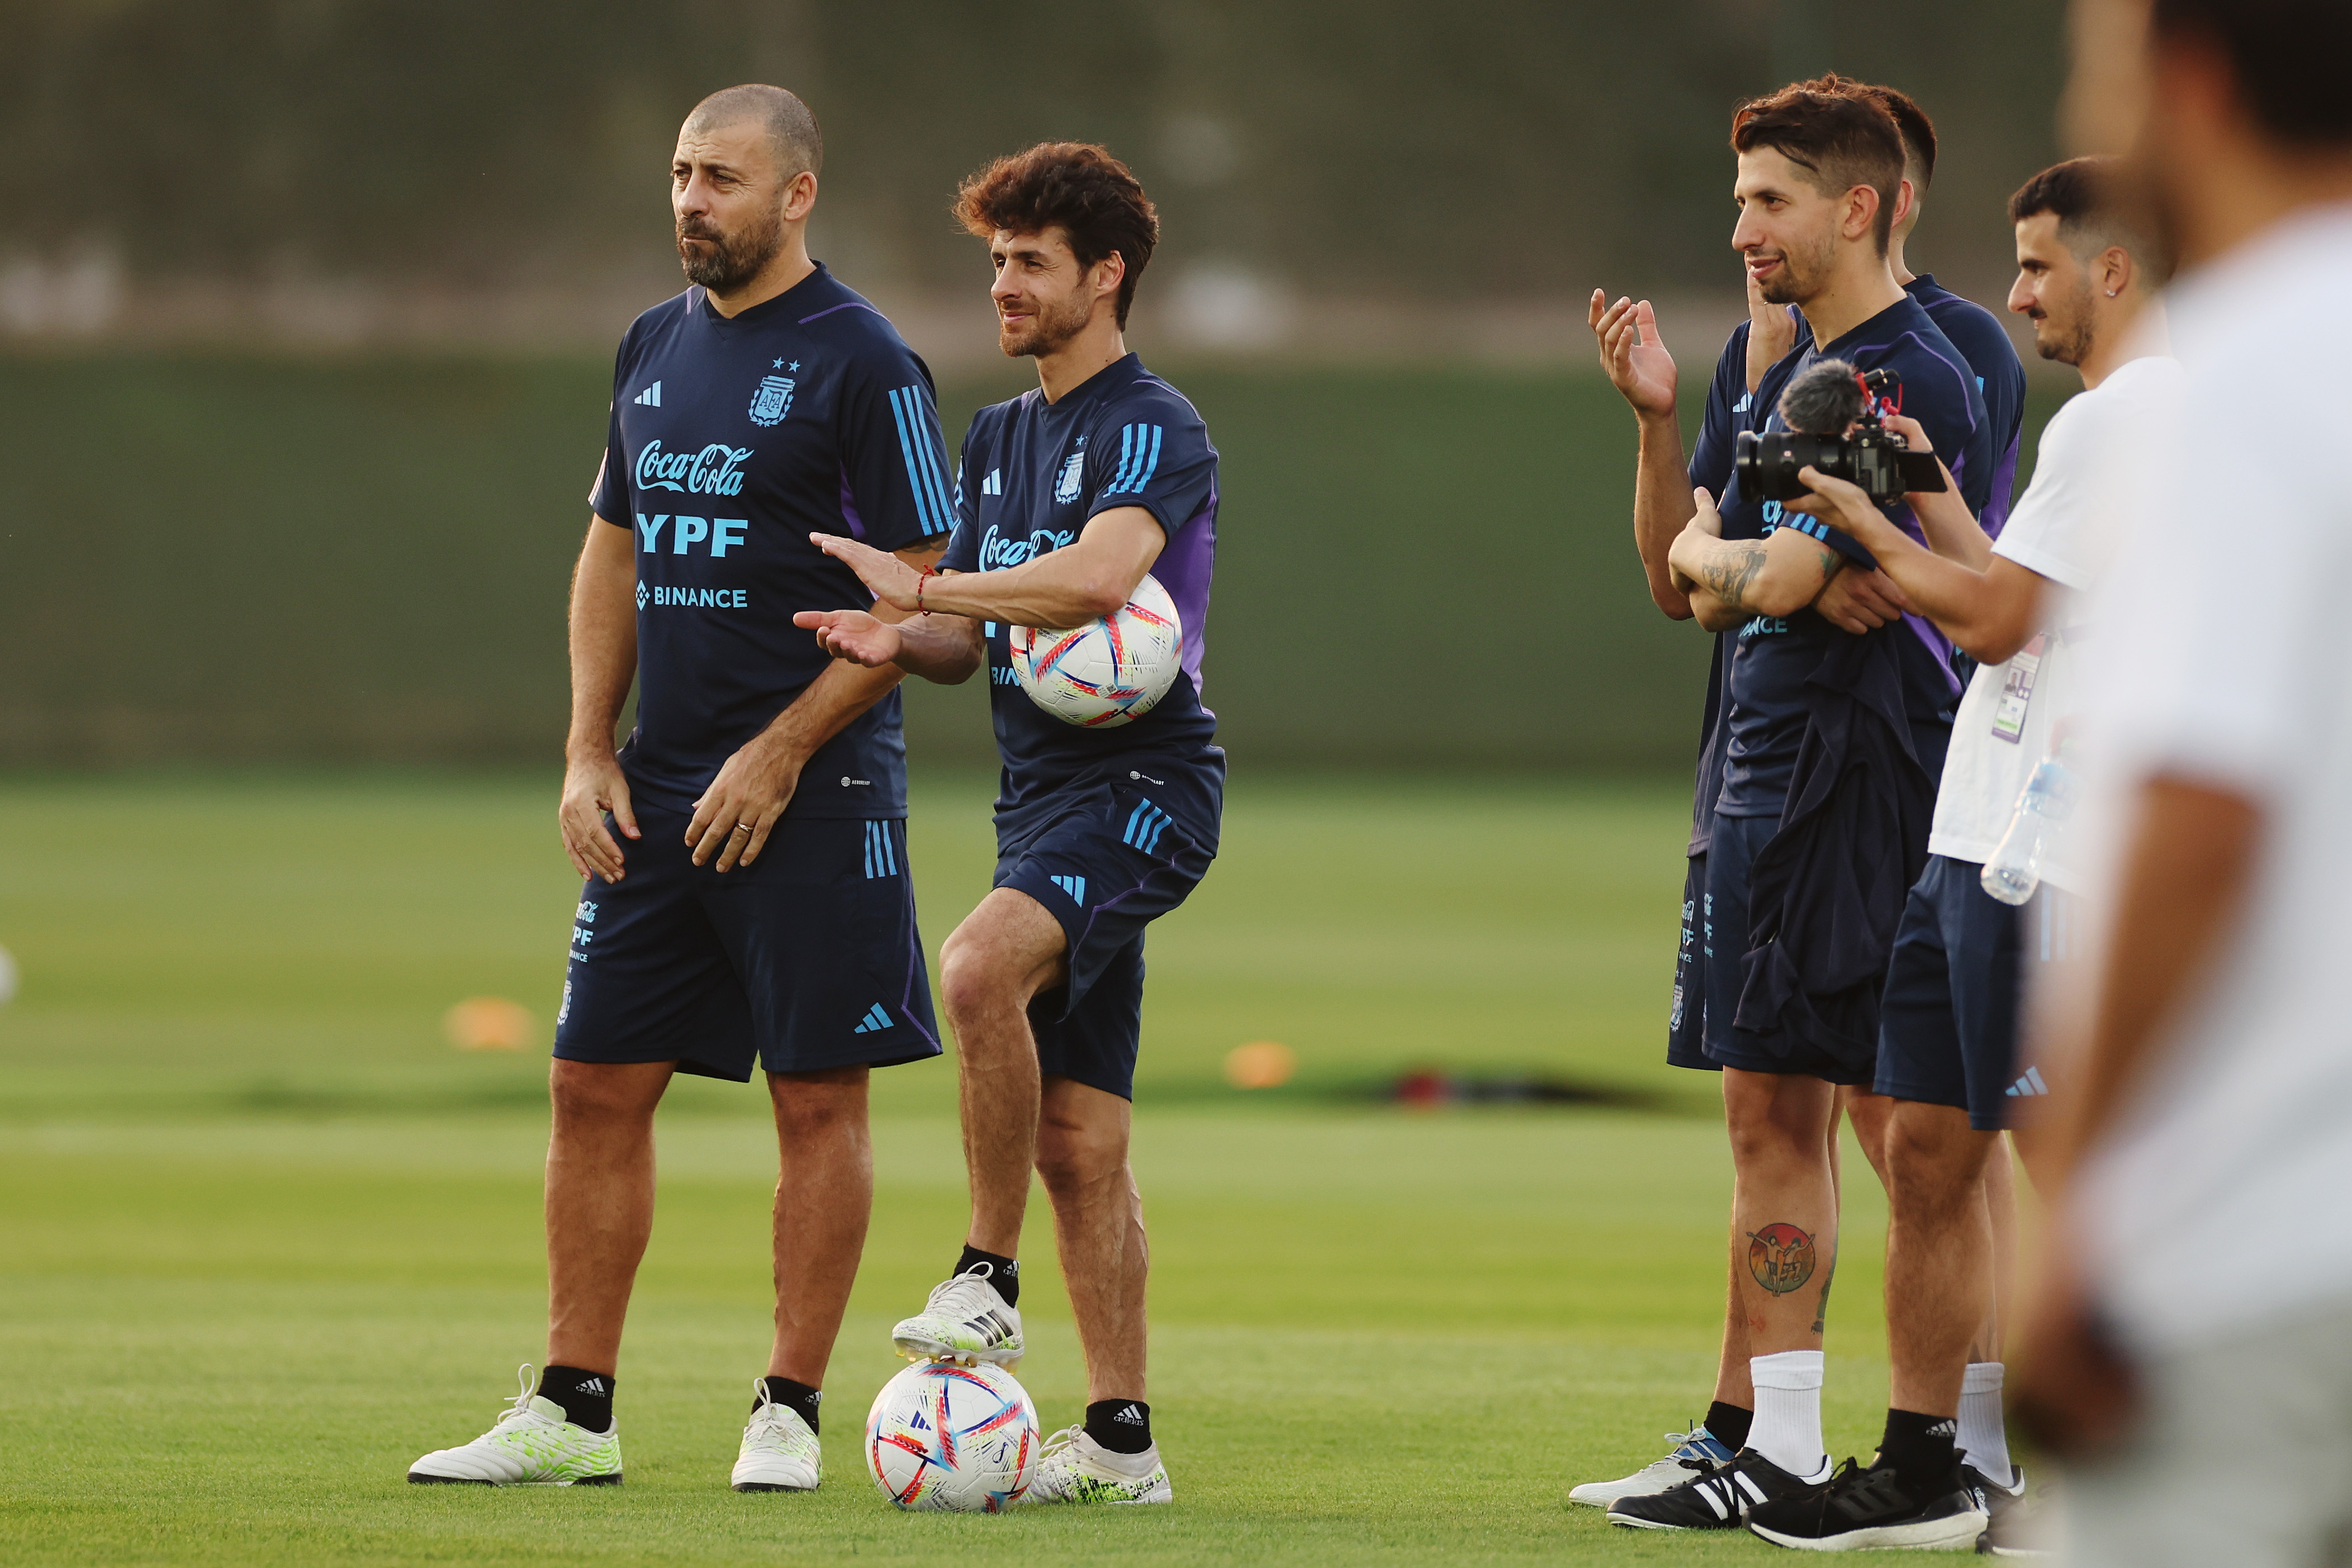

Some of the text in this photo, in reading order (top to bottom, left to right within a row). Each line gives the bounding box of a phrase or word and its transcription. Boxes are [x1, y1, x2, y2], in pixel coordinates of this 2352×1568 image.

[759, 389, 783, 412] AFA
[636, 439, 754, 496] Coca-Cola
[636, 513, 748, 558] YPF
[654, 586, 748, 608] BINANCE
[572, 925, 593, 947] PF
[576, 1386, 606, 1398] adidas
[1113, 1416, 1144, 1426] adidas
